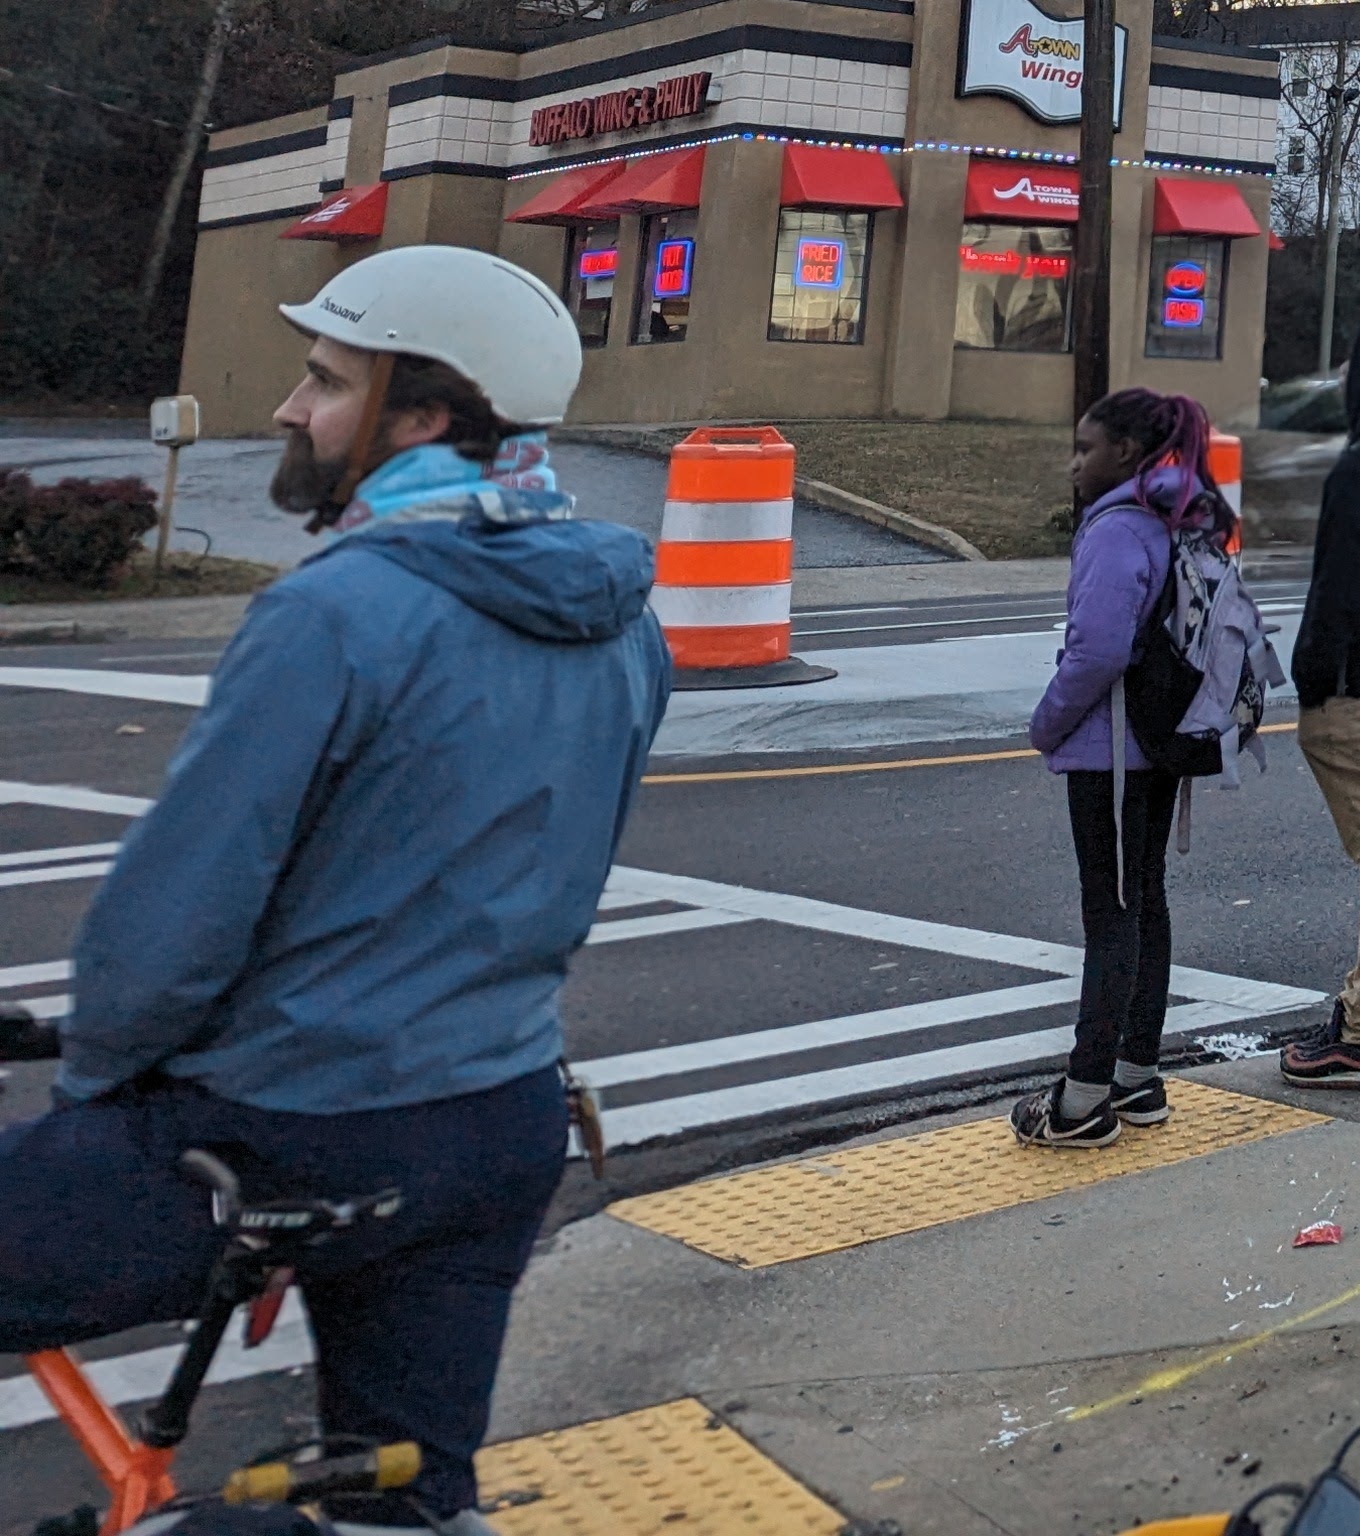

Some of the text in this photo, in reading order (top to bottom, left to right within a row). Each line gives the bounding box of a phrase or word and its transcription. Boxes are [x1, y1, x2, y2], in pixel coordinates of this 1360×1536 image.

[1021, 60, 1083, 89] Wing
[529, 71, 712, 147] BUFFALO WING & PHILLY
[1033, 185, 1072, 195] TOWN
[1036, 195, 1080, 206] WINGS
[800, 243, 840, 263] FRIED
[802, 264, 834, 282] RICE
[1168, 301, 1200, 322] FISH
